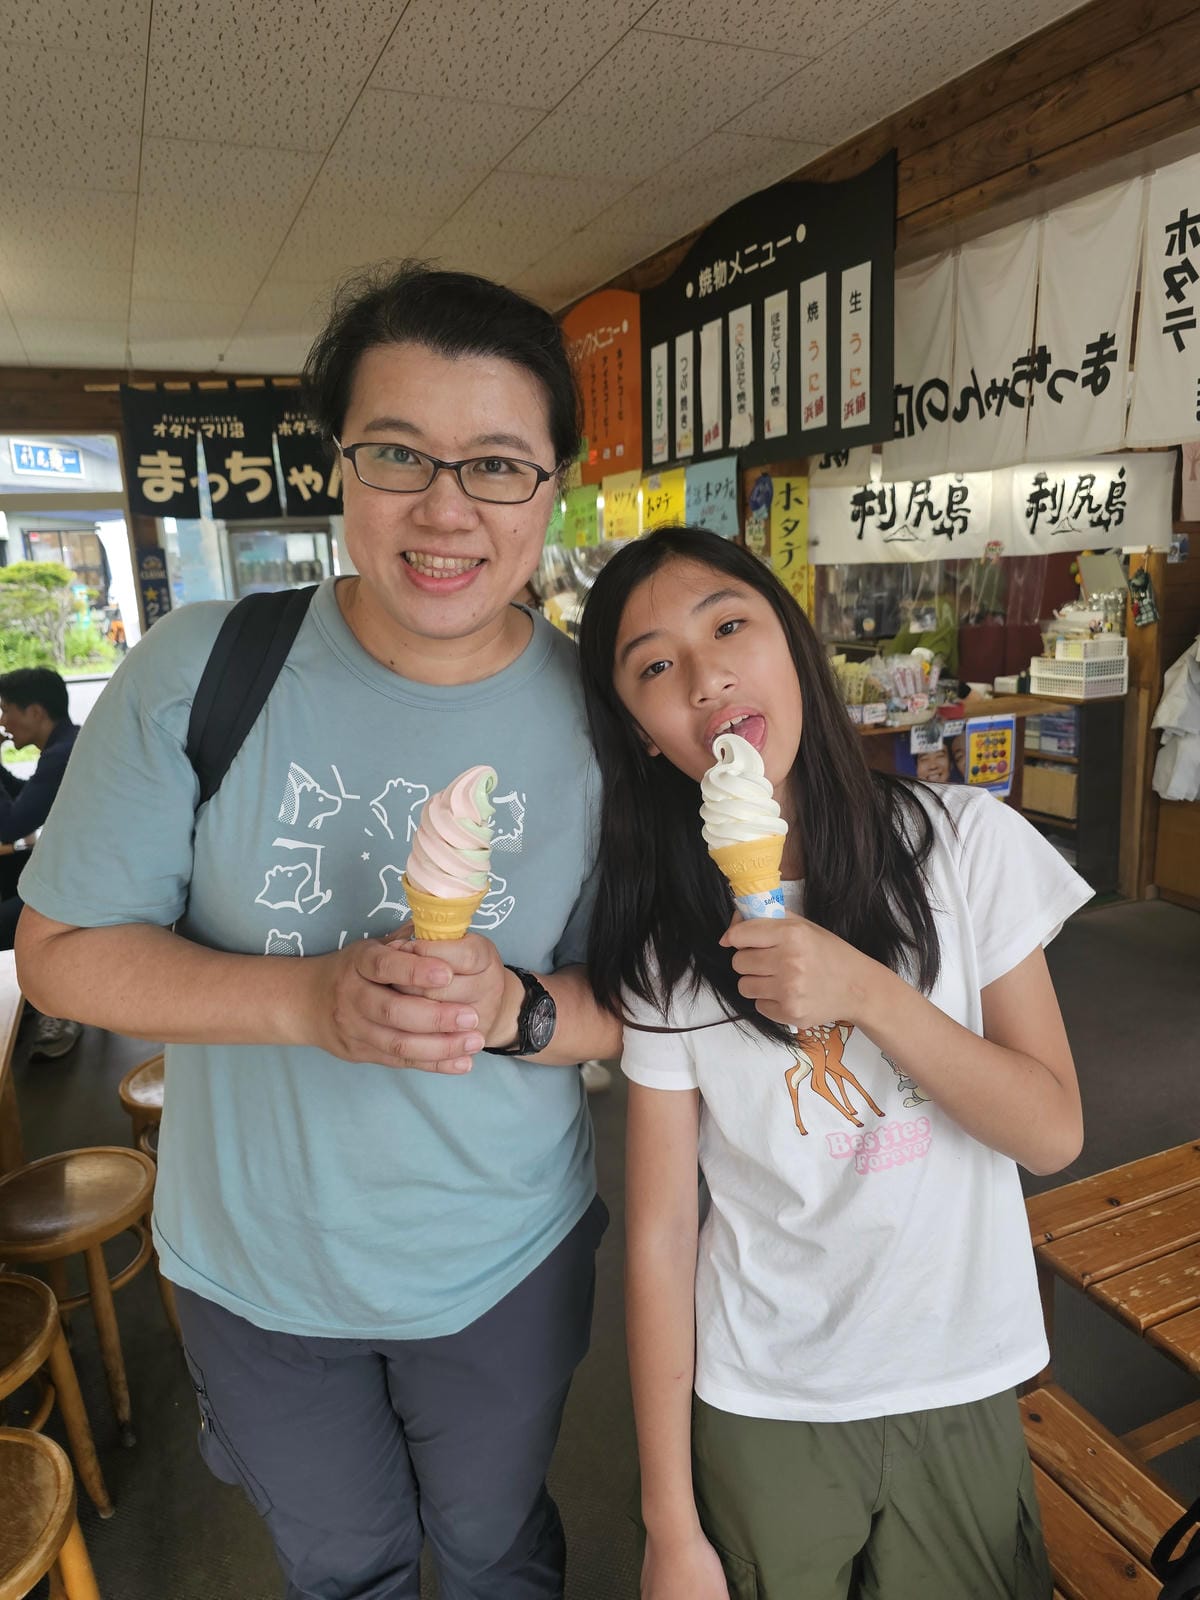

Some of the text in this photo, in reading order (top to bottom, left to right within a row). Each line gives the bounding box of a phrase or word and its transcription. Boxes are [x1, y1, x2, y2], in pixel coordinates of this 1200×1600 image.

[699, 236, 792, 297] 焼物メニュー
[807, 301, 819, 392] 焼うに
[849, 290, 862, 387] 生うに
[153, 422, 245, 438] オタトマリ沼
[775, 482, 804, 570] ホタテ
[850, 480, 971, 541] 利尻島
[1026, 466, 1127, 535] 利尻島
[826, 1116, 932, 1159] Besties
